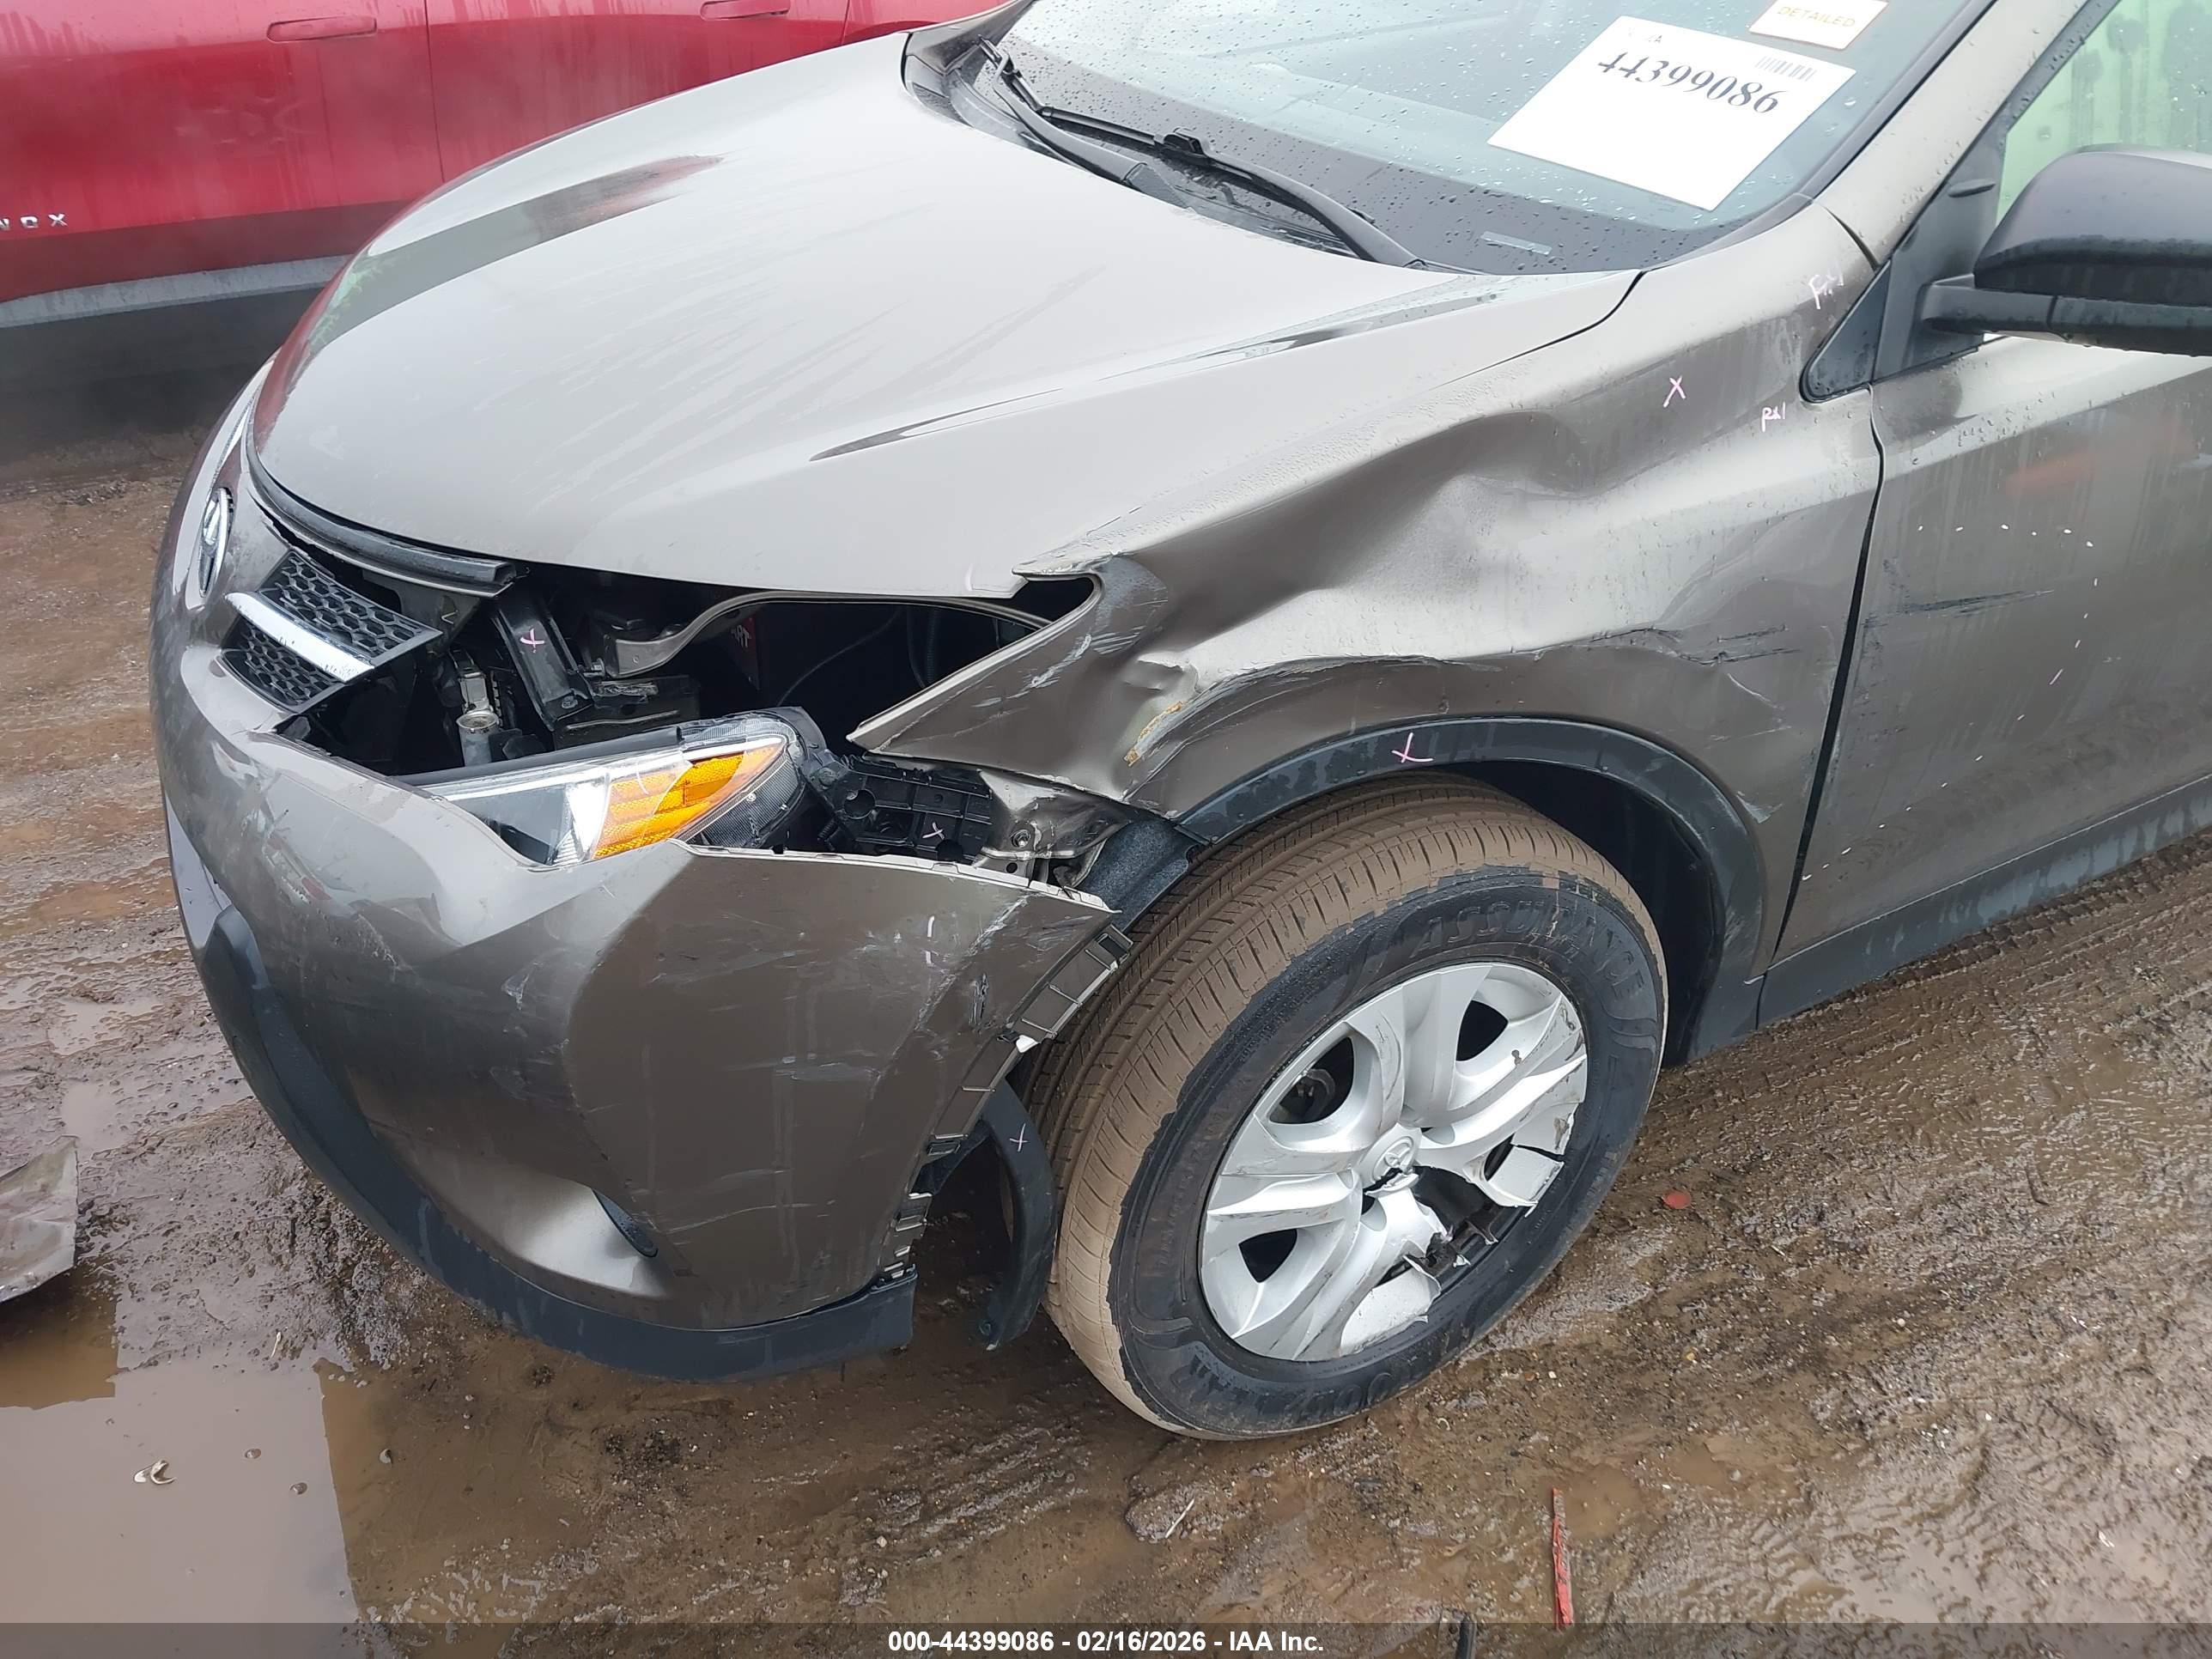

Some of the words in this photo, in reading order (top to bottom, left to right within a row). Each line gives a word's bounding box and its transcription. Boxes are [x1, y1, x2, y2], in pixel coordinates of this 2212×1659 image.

[1778, 6, 1856, 27] DETAILED
[1597, 52, 1787, 113] 44399086
[1408, 900, 1647, 1001] ASSURANCE
